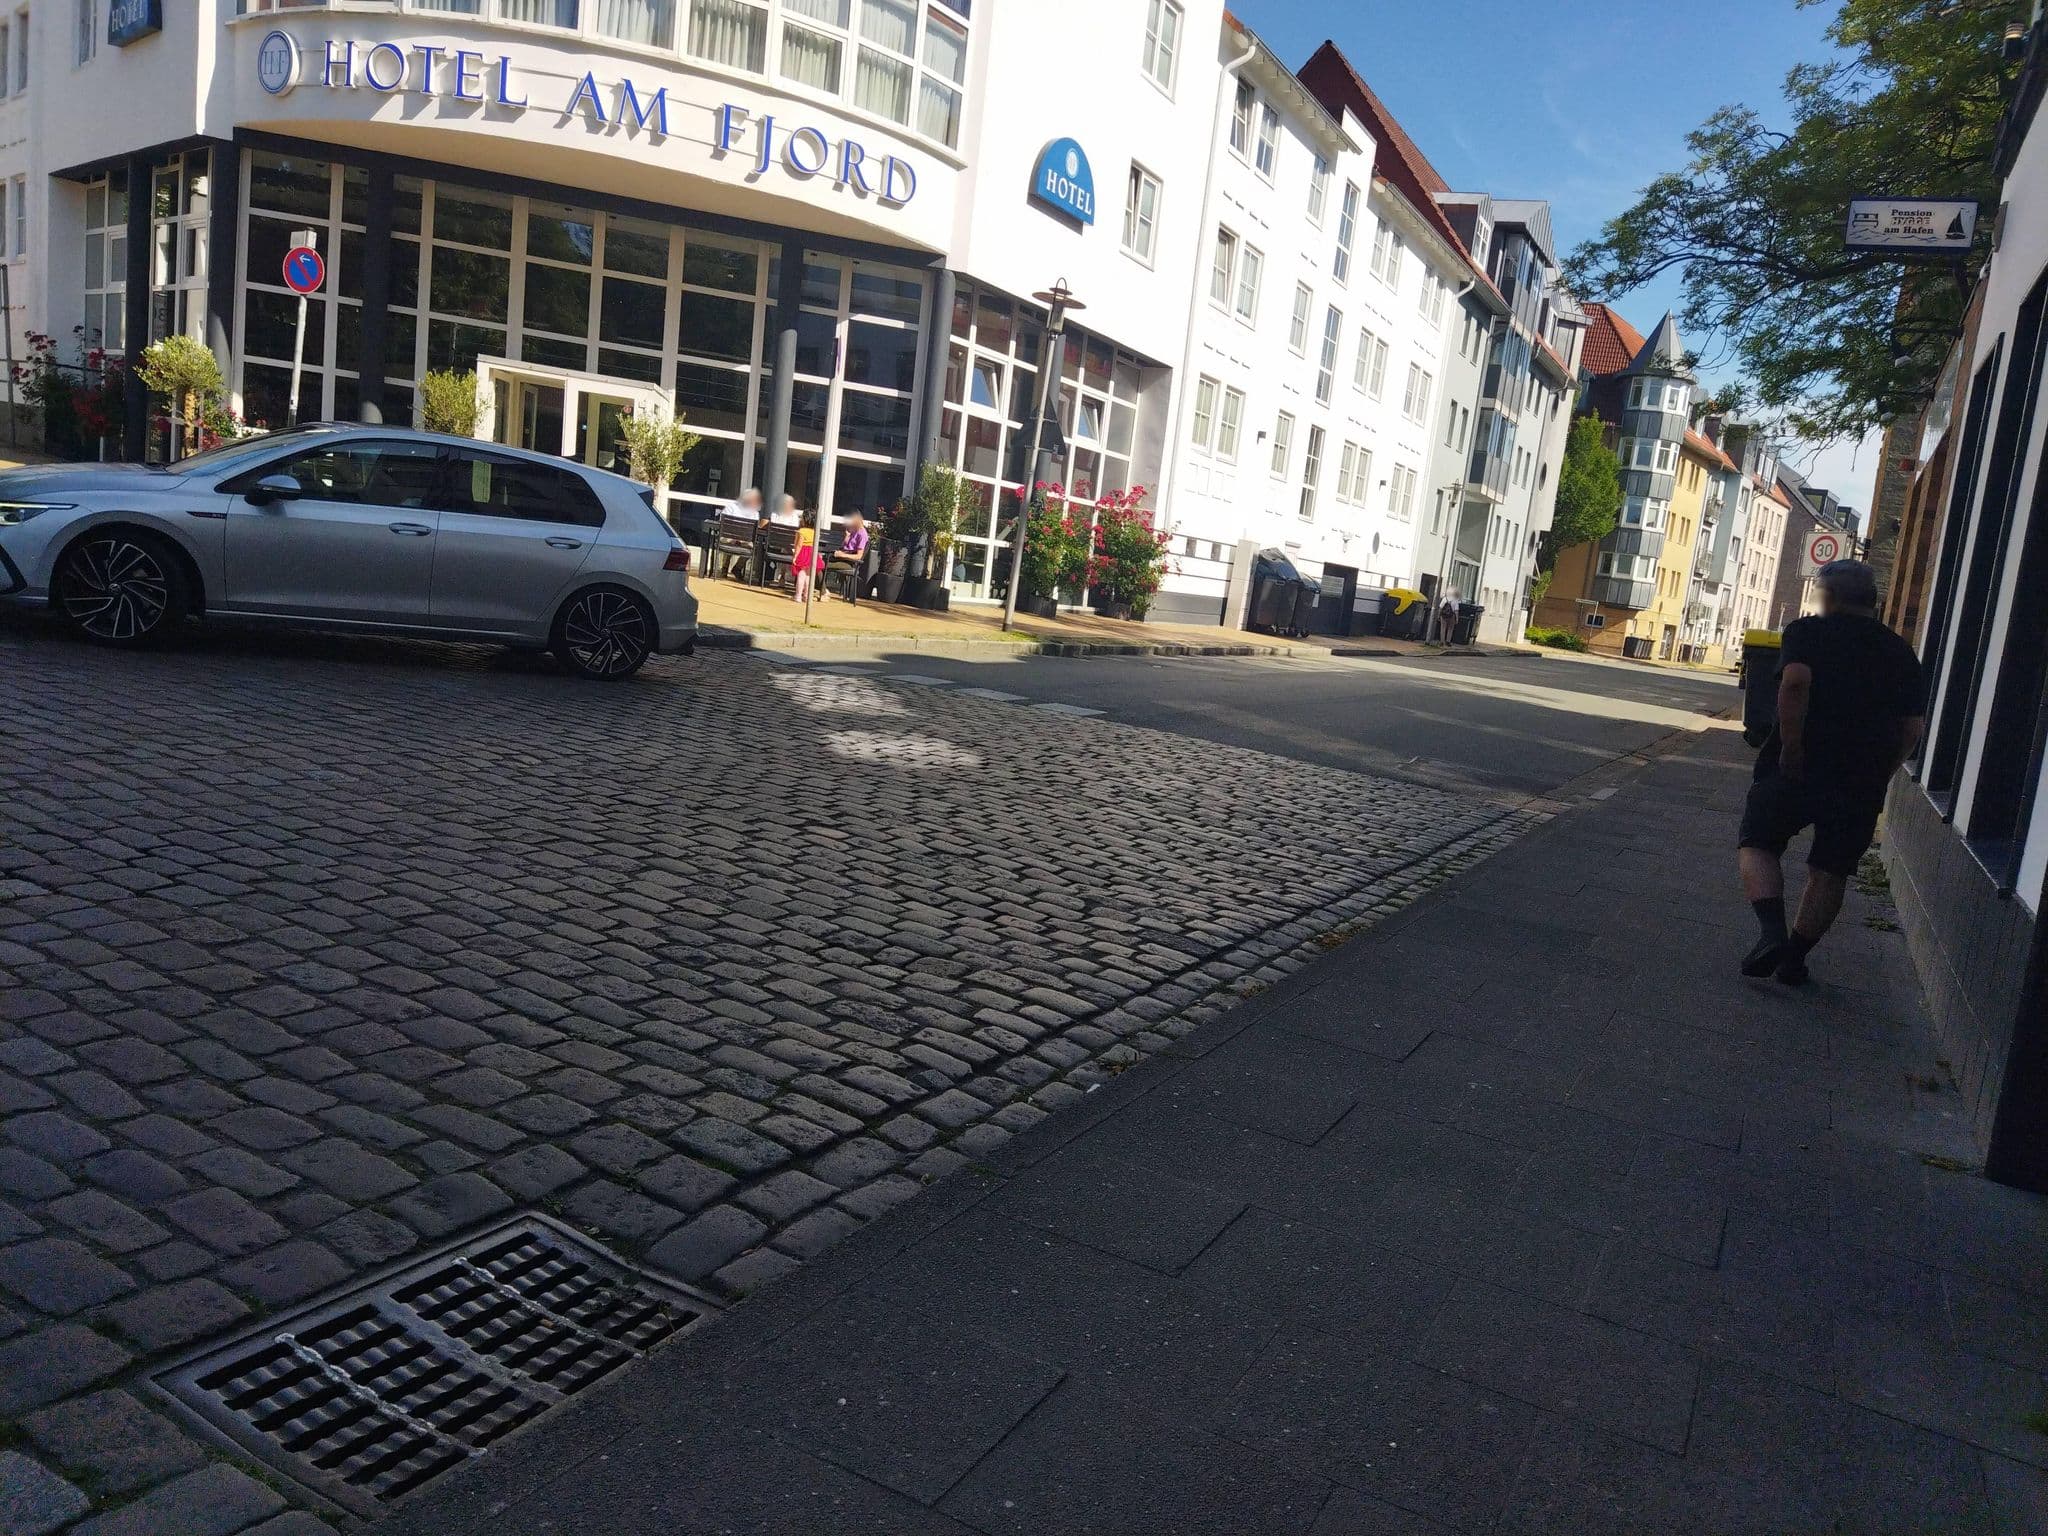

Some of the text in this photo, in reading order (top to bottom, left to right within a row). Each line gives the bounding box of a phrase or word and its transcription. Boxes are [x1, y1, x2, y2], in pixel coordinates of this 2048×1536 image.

[323, 40, 916, 204] HOTEL AM FJORD
[1046, 168, 1092, 216] HOTEL
[1891, 209, 1933, 217] Pension
[1902, 226, 1934, 234] Hafen
[1816, 543, 1833, 558] 30
